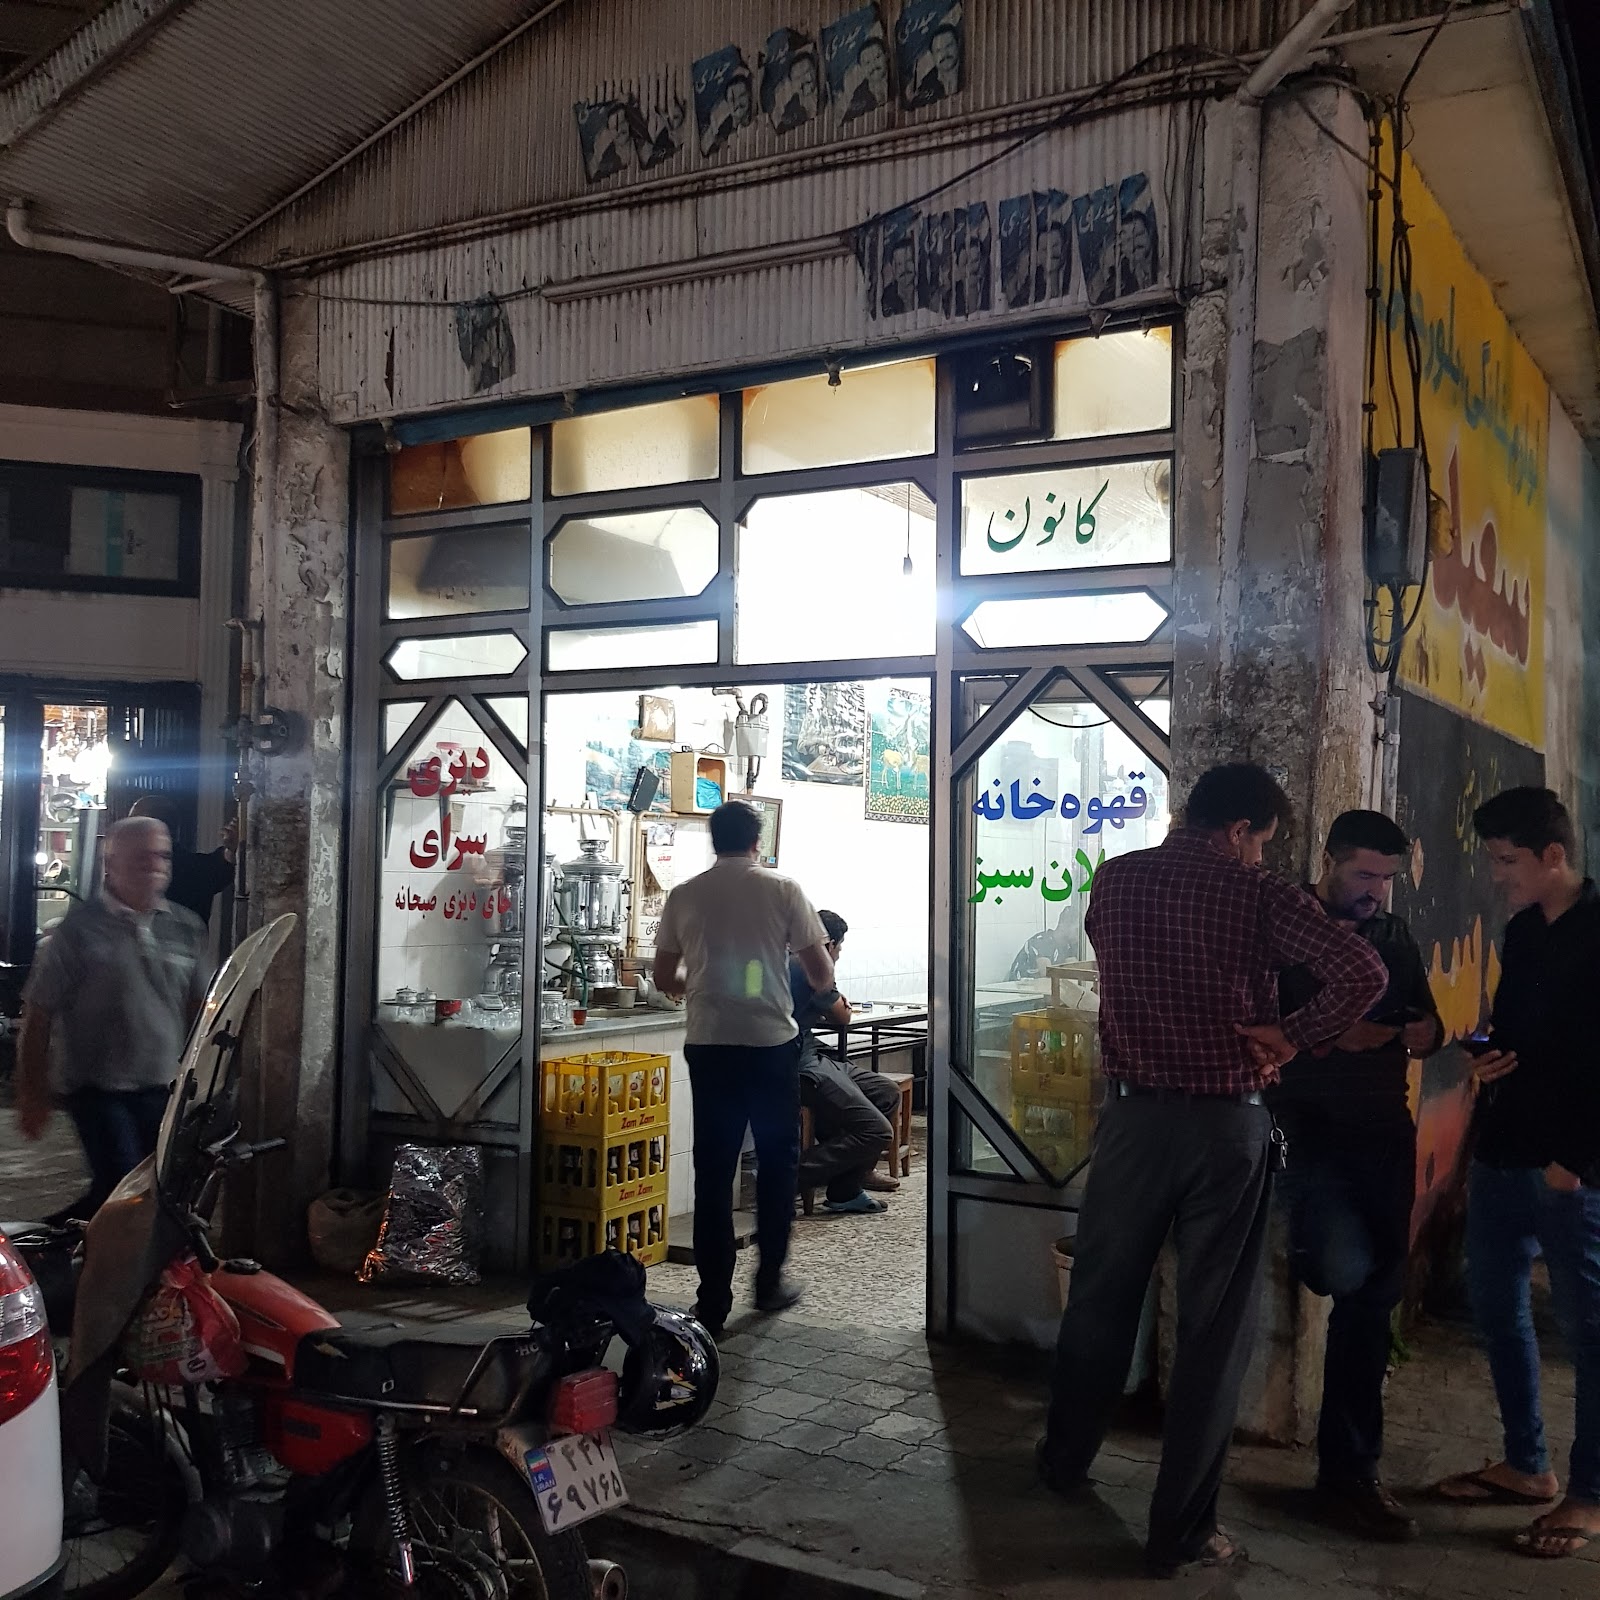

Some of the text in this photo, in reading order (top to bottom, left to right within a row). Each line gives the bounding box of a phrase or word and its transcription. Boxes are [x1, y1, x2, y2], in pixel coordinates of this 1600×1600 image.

[987, 478, 1109, 553] کانون
[411, 746, 490, 797] دیزی
[972, 770, 1147, 834] قهوه خانه
[410, 812, 487, 870] سرای
[395, 885, 437, 919] صبحانه
[443, 889, 477, 920] دیزی
[967, 857, 1034, 905] سبز
[621, 1113, 655, 1129] Zam Zam
[619, 1184, 653, 1201] Zam Zam
[548, 1470, 622, 1524] ۶۹۷۶۵
